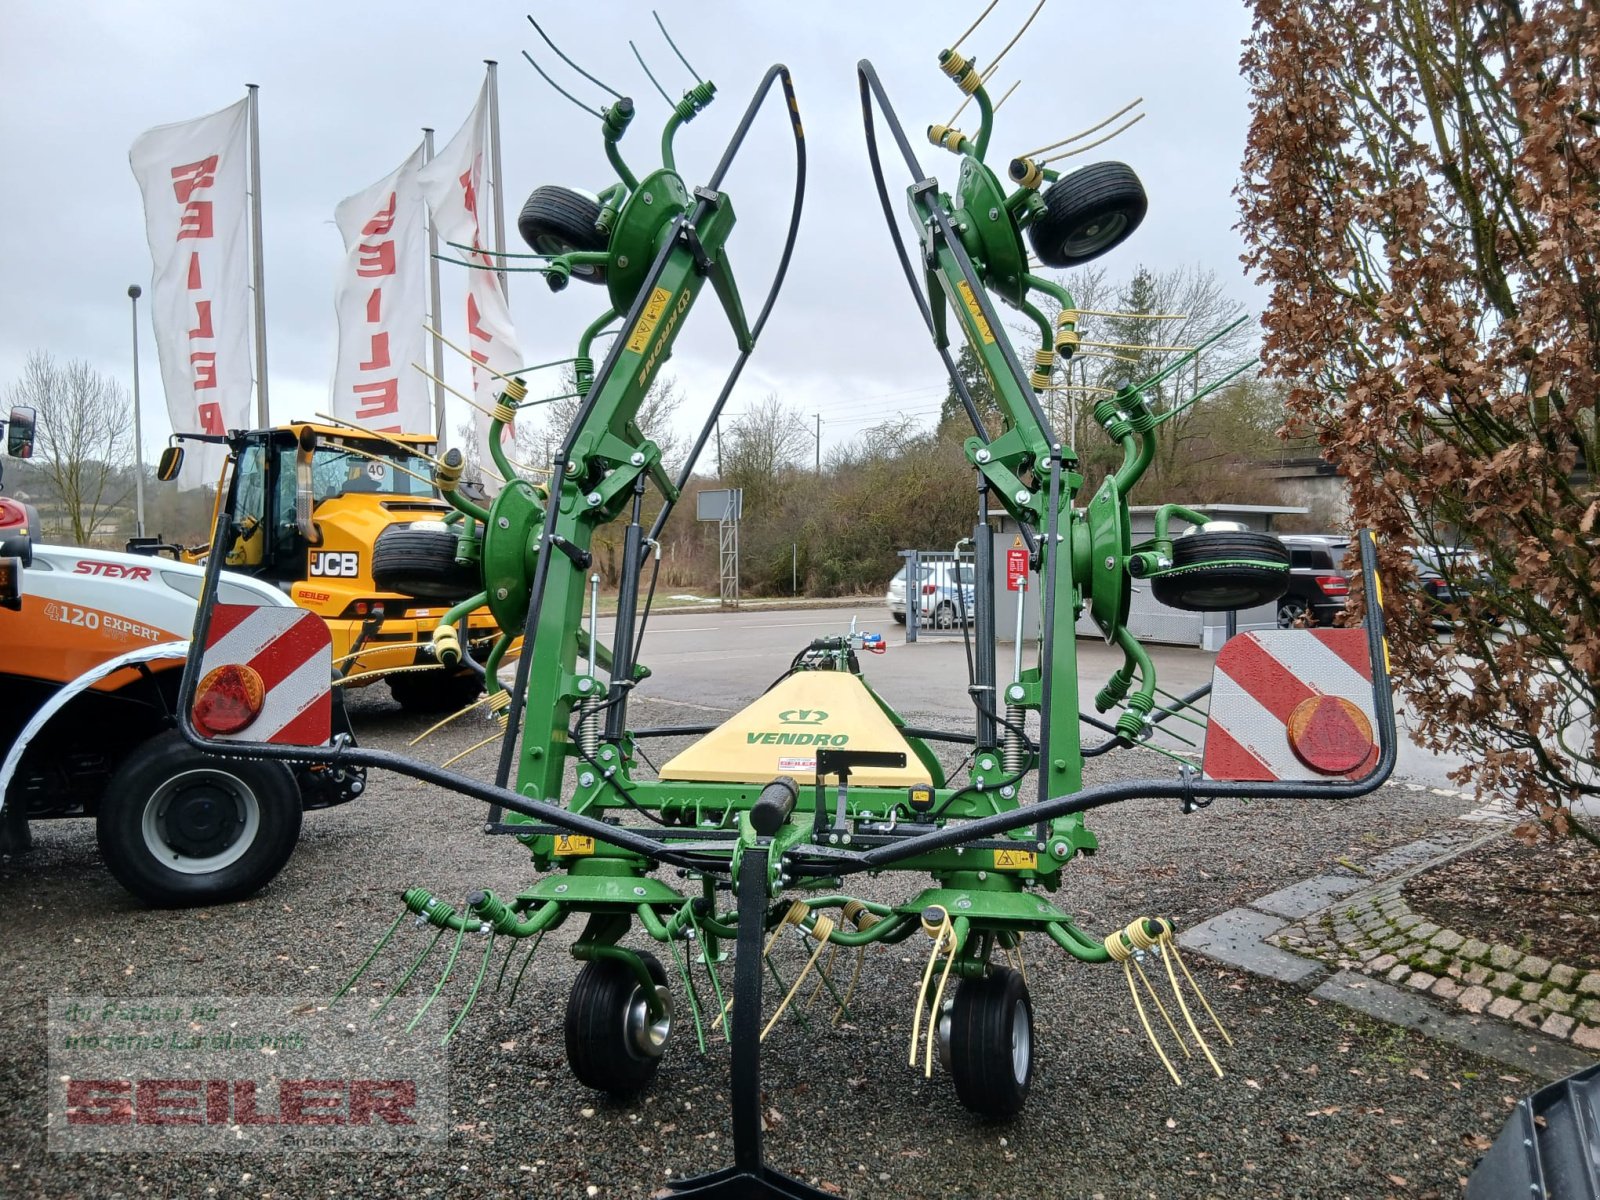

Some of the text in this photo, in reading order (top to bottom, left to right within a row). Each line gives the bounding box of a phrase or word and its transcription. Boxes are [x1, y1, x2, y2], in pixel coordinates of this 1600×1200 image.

[639, 308, 678, 388] KRONE
[368, 464, 384, 476] 40
[72, 560, 152, 581] STEYR
[310, 552, 358, 576] JCB
[43, 602, 160, 641] 4120 EXPERT
[747, 732, 849, 746] VENDRO
